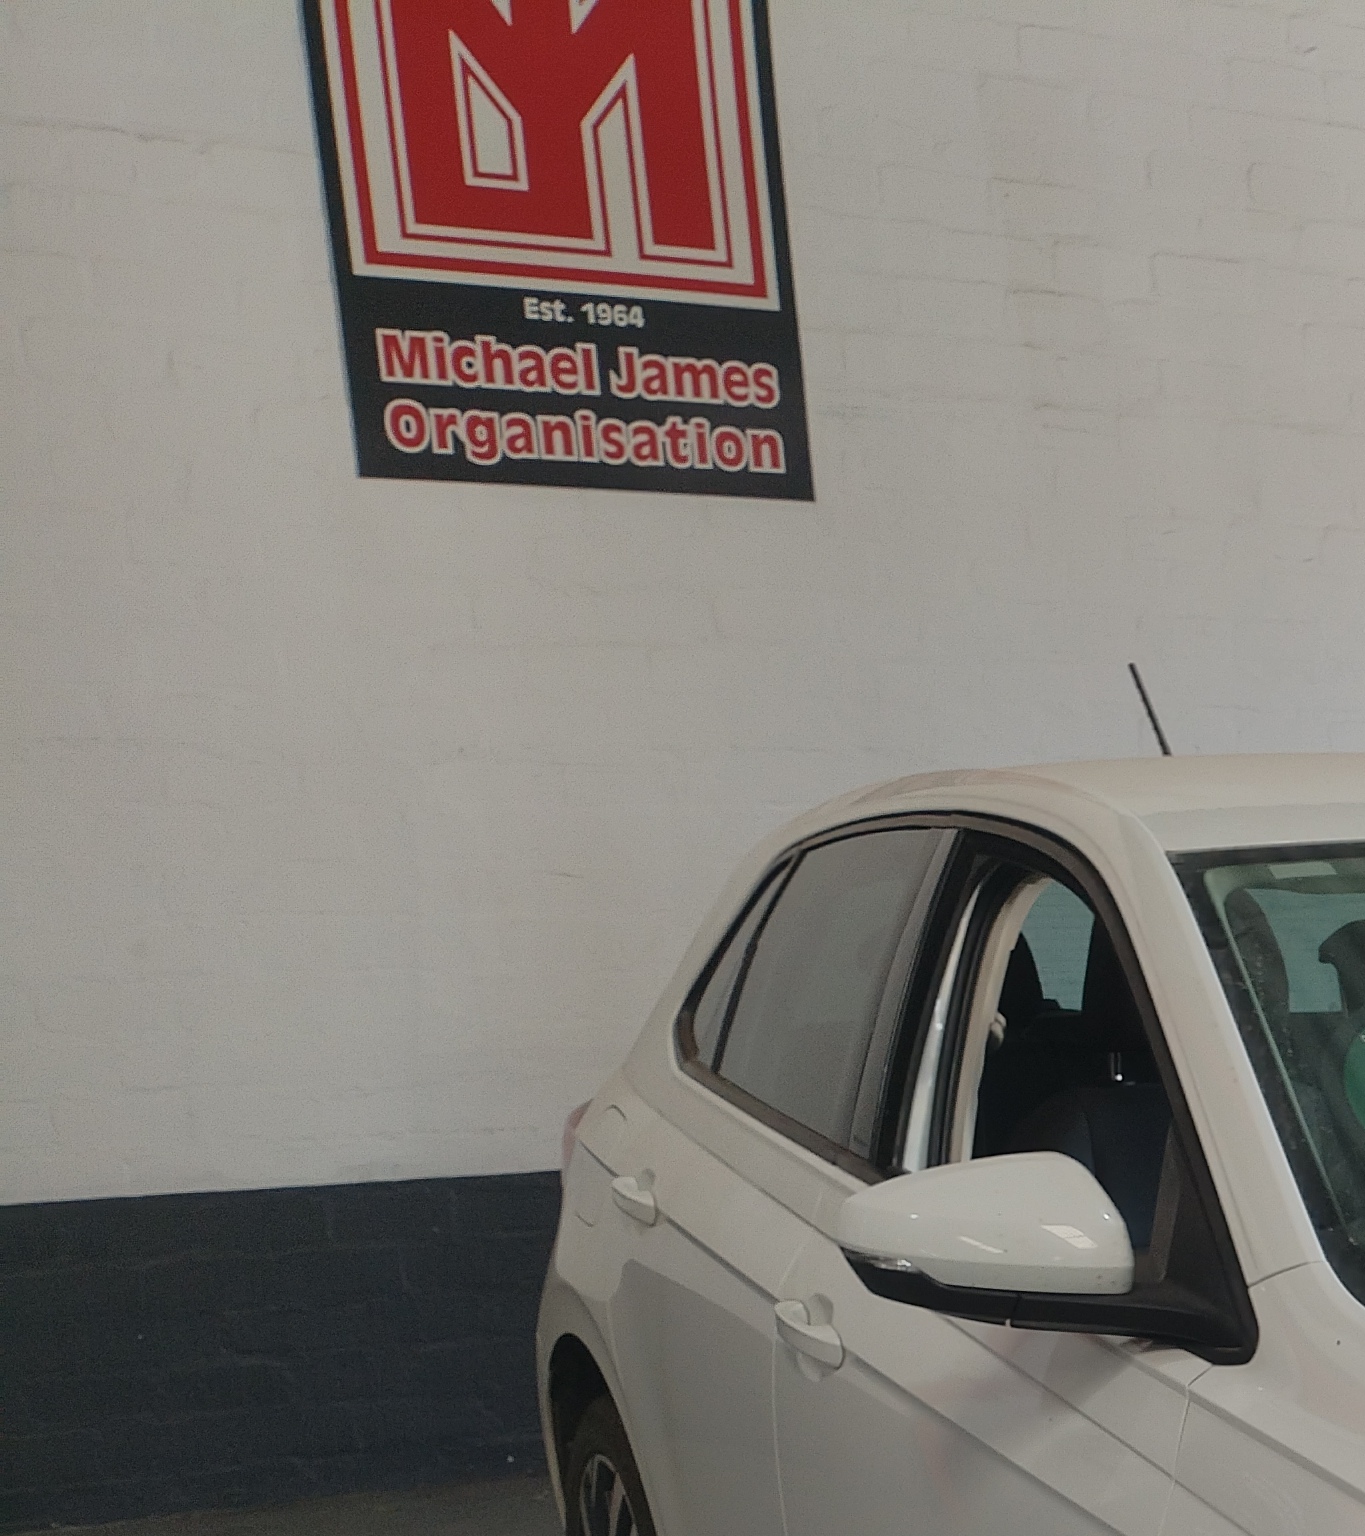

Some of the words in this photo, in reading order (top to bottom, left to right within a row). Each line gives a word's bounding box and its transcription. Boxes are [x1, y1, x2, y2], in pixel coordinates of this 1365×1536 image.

[523, 296, 574, 324] Est.
[580, 302, 645, 328] 1964
[374, 327, 601, 396] Michael
[610, 344, 779, 408] James
[384, 398, 786, 474] Organisation
